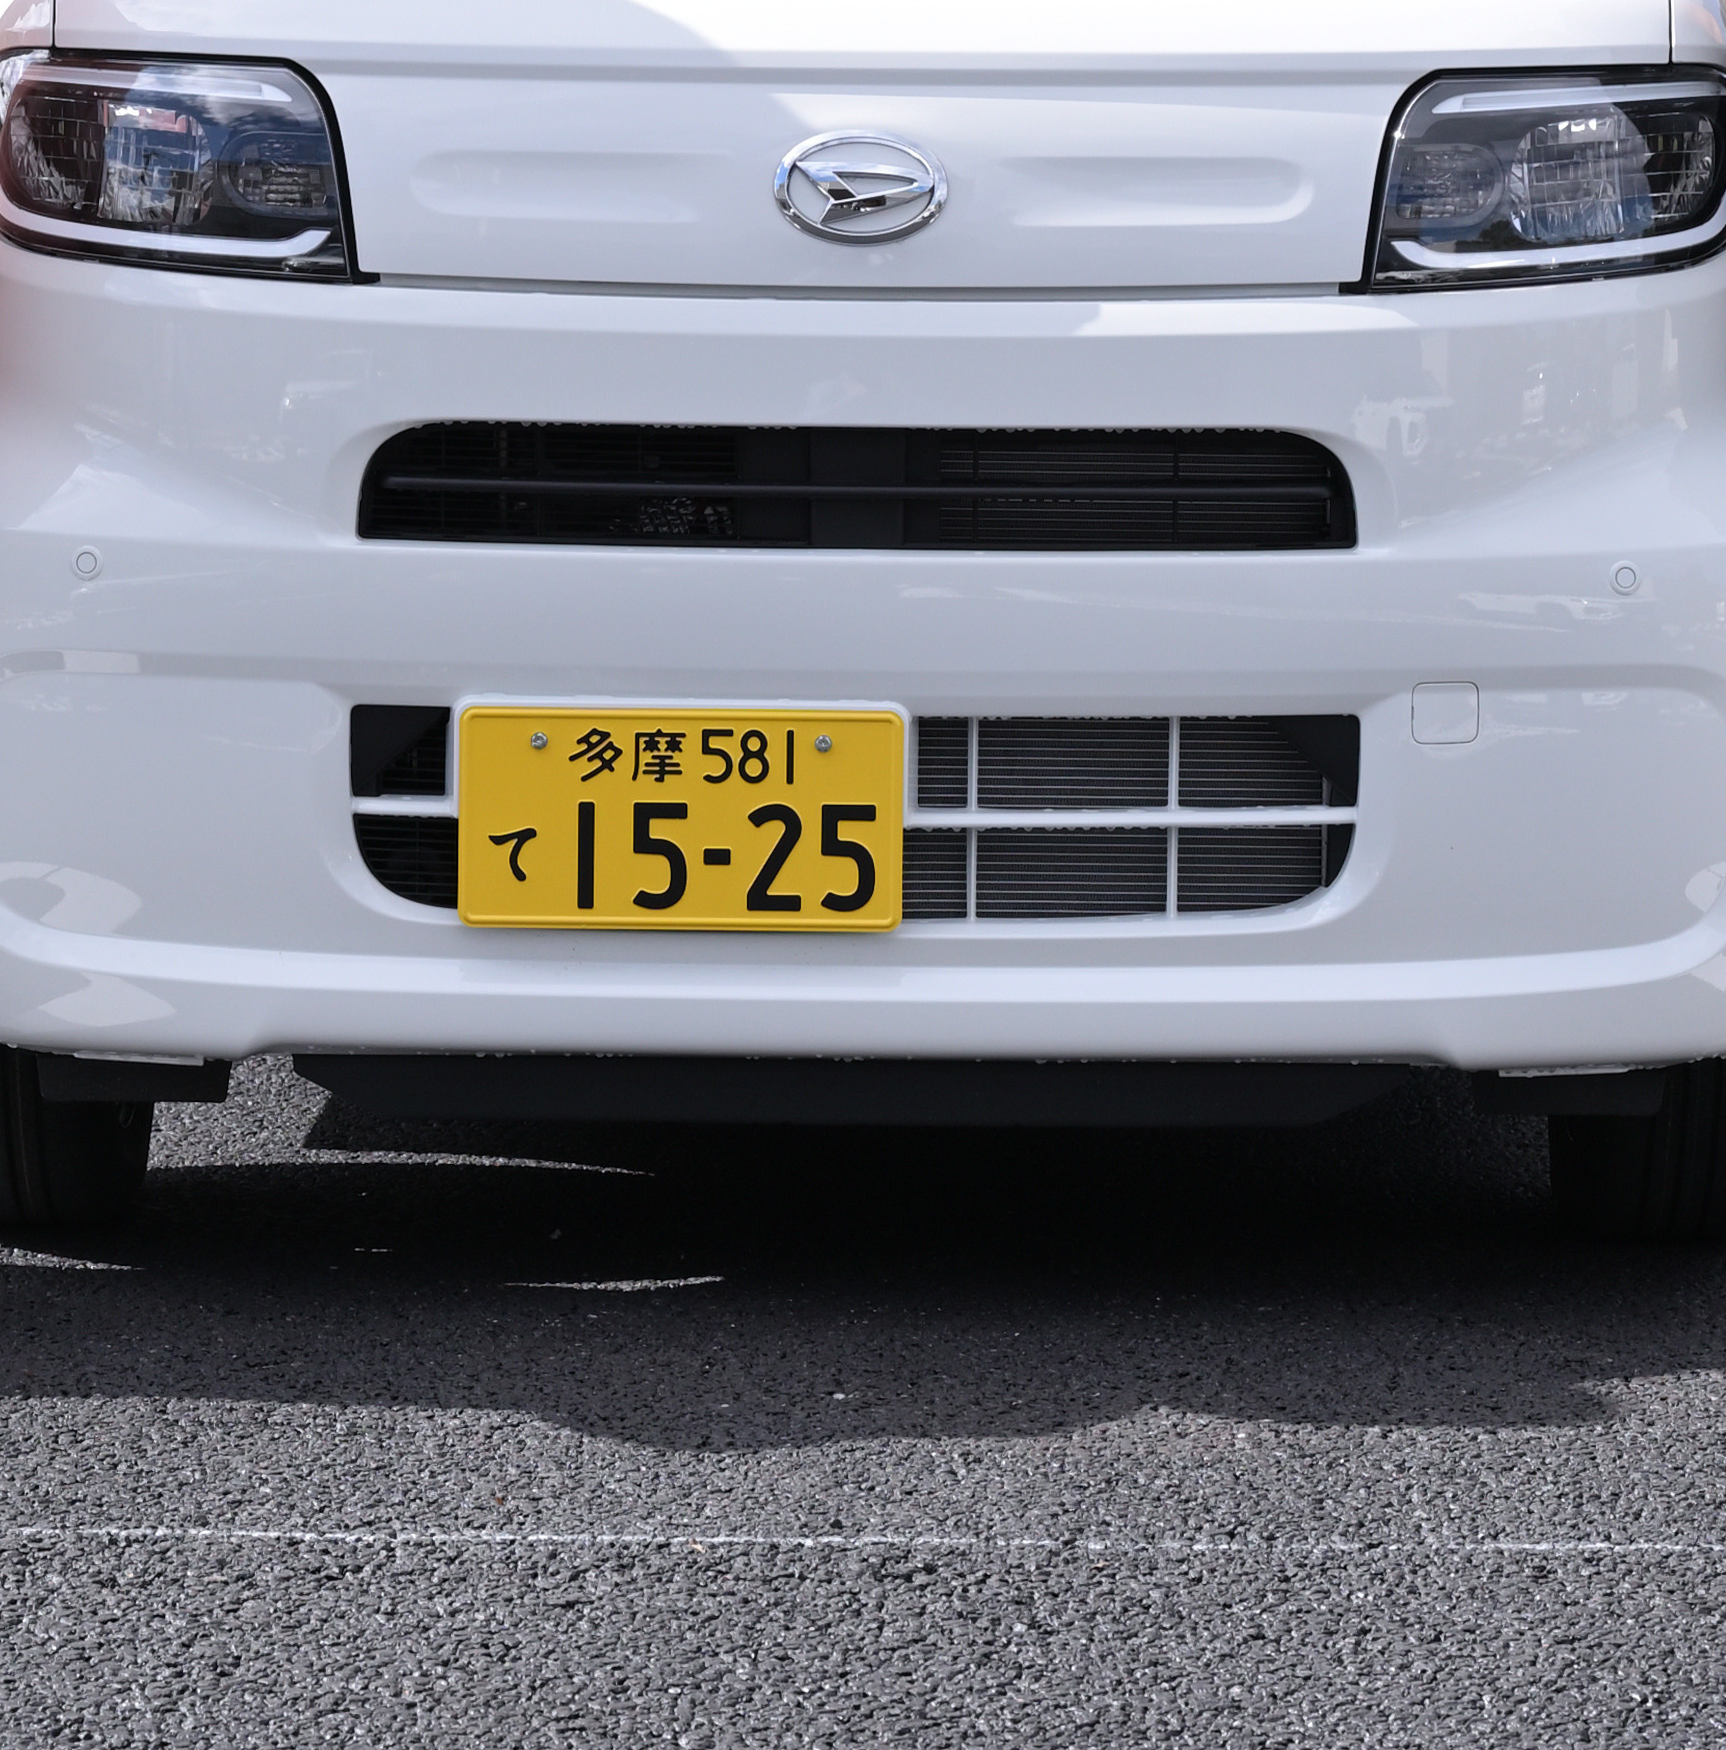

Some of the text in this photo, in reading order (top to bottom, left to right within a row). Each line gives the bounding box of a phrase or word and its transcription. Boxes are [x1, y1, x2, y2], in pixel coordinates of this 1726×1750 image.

[568, 727, 796, 785] 多摩 581
[488, 800, 877, 913] て 15-25
